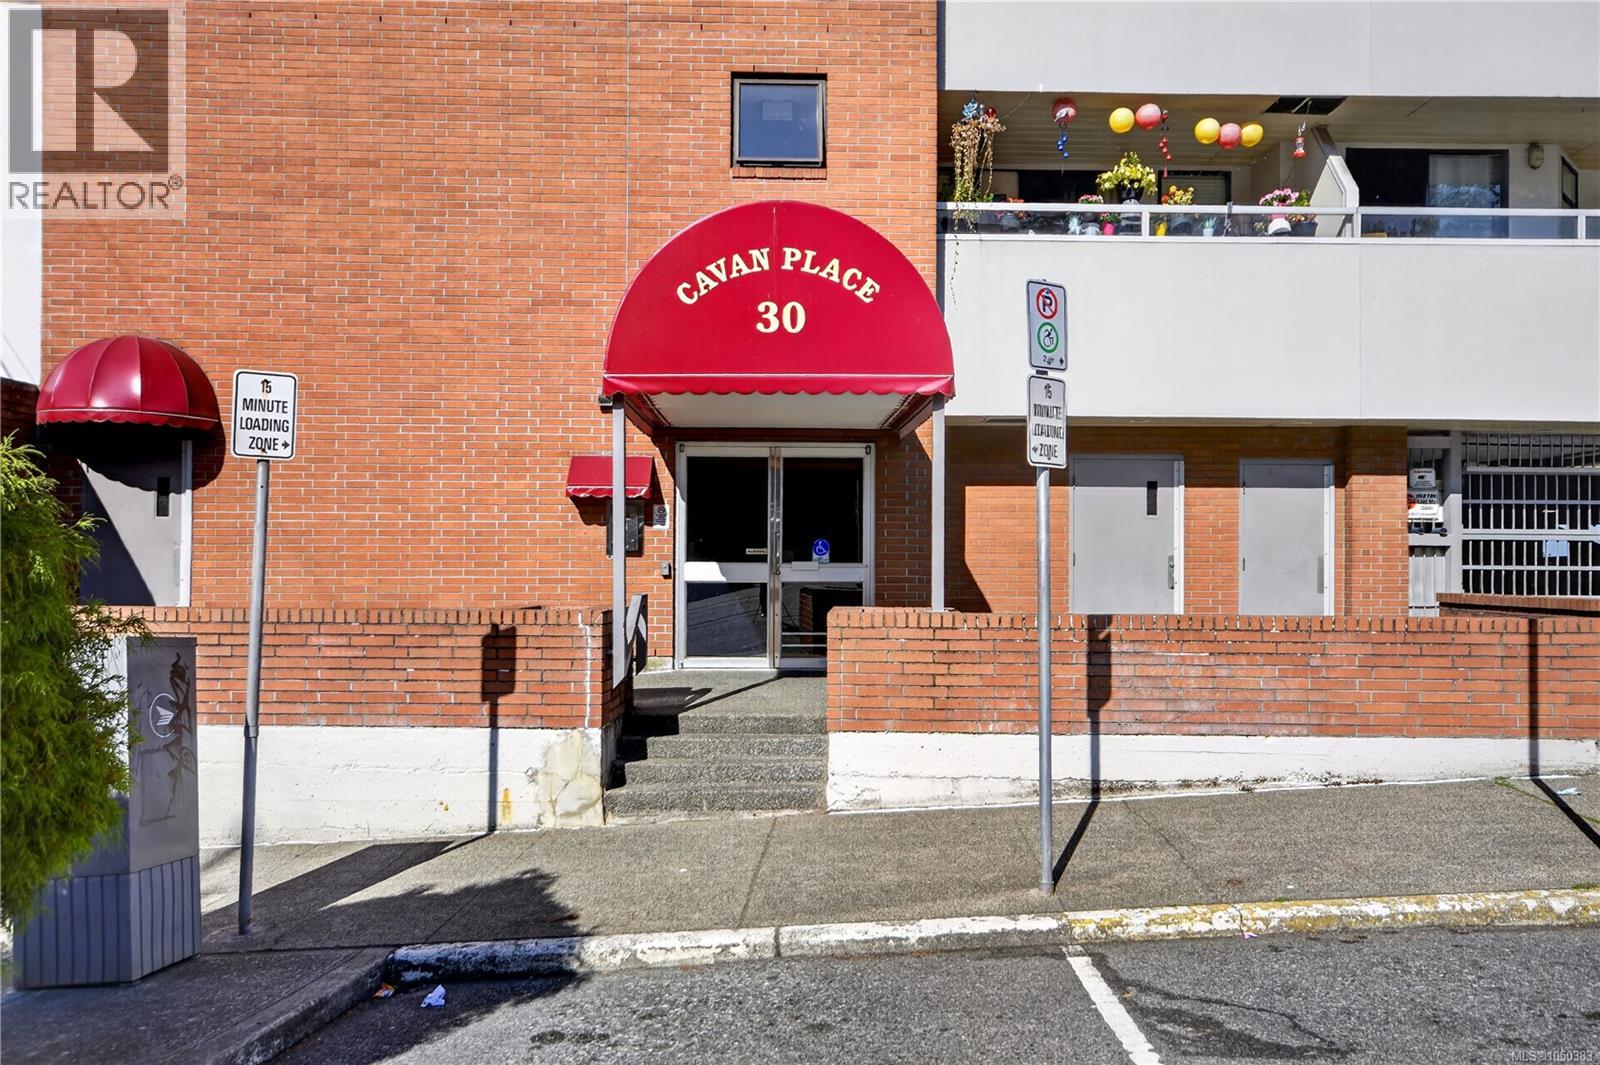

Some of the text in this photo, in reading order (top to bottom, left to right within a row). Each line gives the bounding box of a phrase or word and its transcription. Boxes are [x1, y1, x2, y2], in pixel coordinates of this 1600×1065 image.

[676, 247, 881, 305] CAVAN PLACE
[755, 300, 806, 334] 30
[260, 379, 272, 394] 15
[242, 397, 289, 414] MINUTE
[239, 416, 290, 433] LOADING
[248, 435, 280, 451] ZONE
[1039, 443, 1058, 458] ZONE
